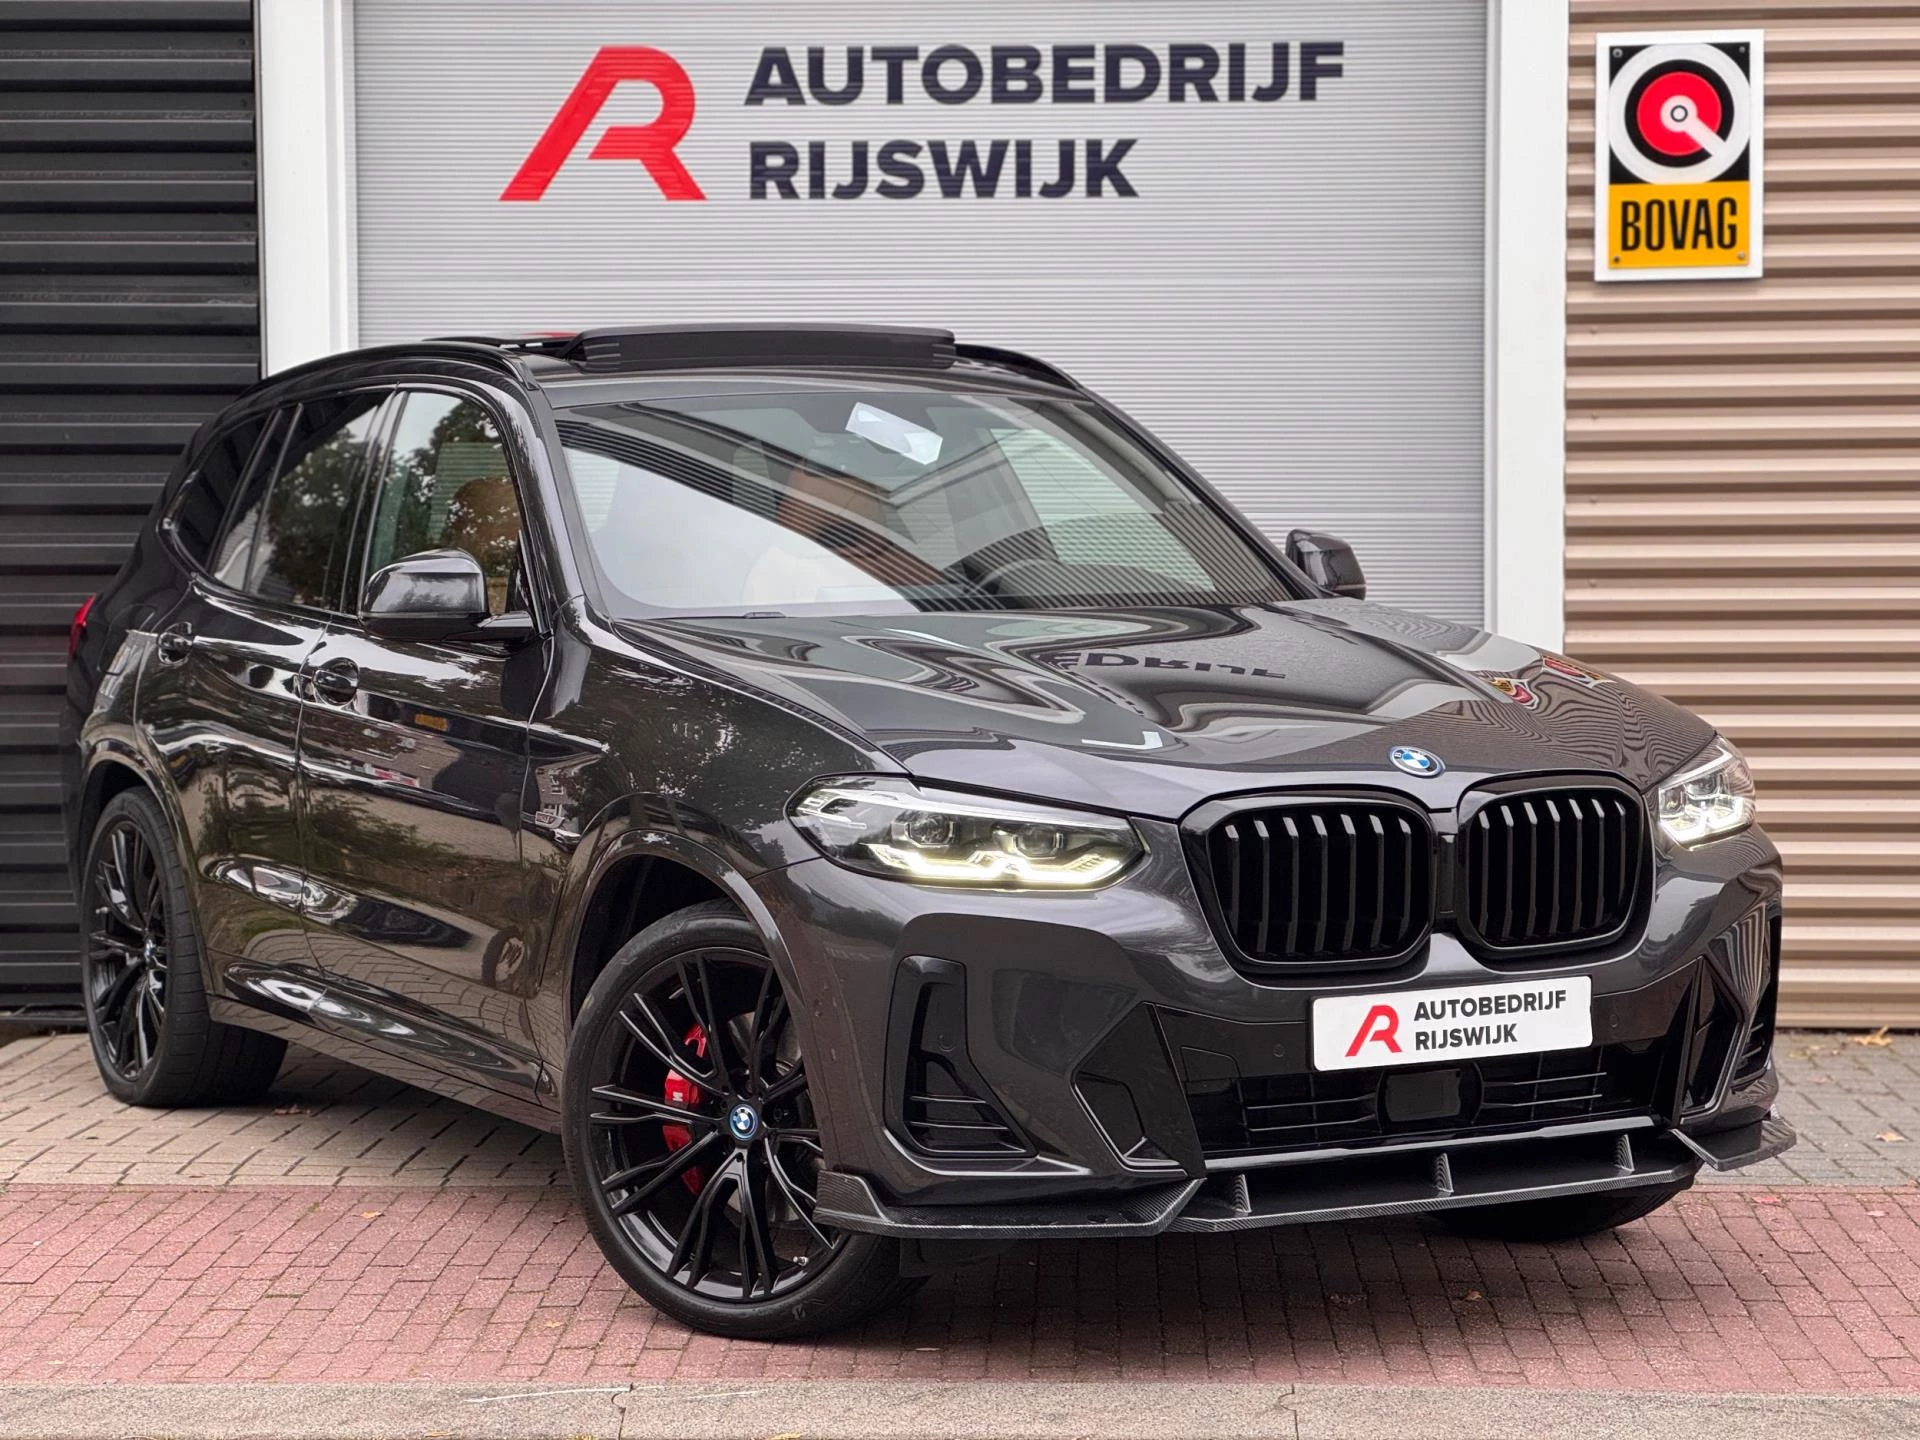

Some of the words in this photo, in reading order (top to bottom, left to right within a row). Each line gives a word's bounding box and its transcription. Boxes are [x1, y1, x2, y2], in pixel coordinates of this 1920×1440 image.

[744, 41, 1344, 106] AUTOBEDRIJF
[749, 138, 1139, 200] RIJSWIJK
[1621, 197, 1737, 252] BOVAG
[1413, 989, 1567, 1022] AUTOBEDRIJF
[1415, 1023, 1518, 1051] RIJSWIJK
